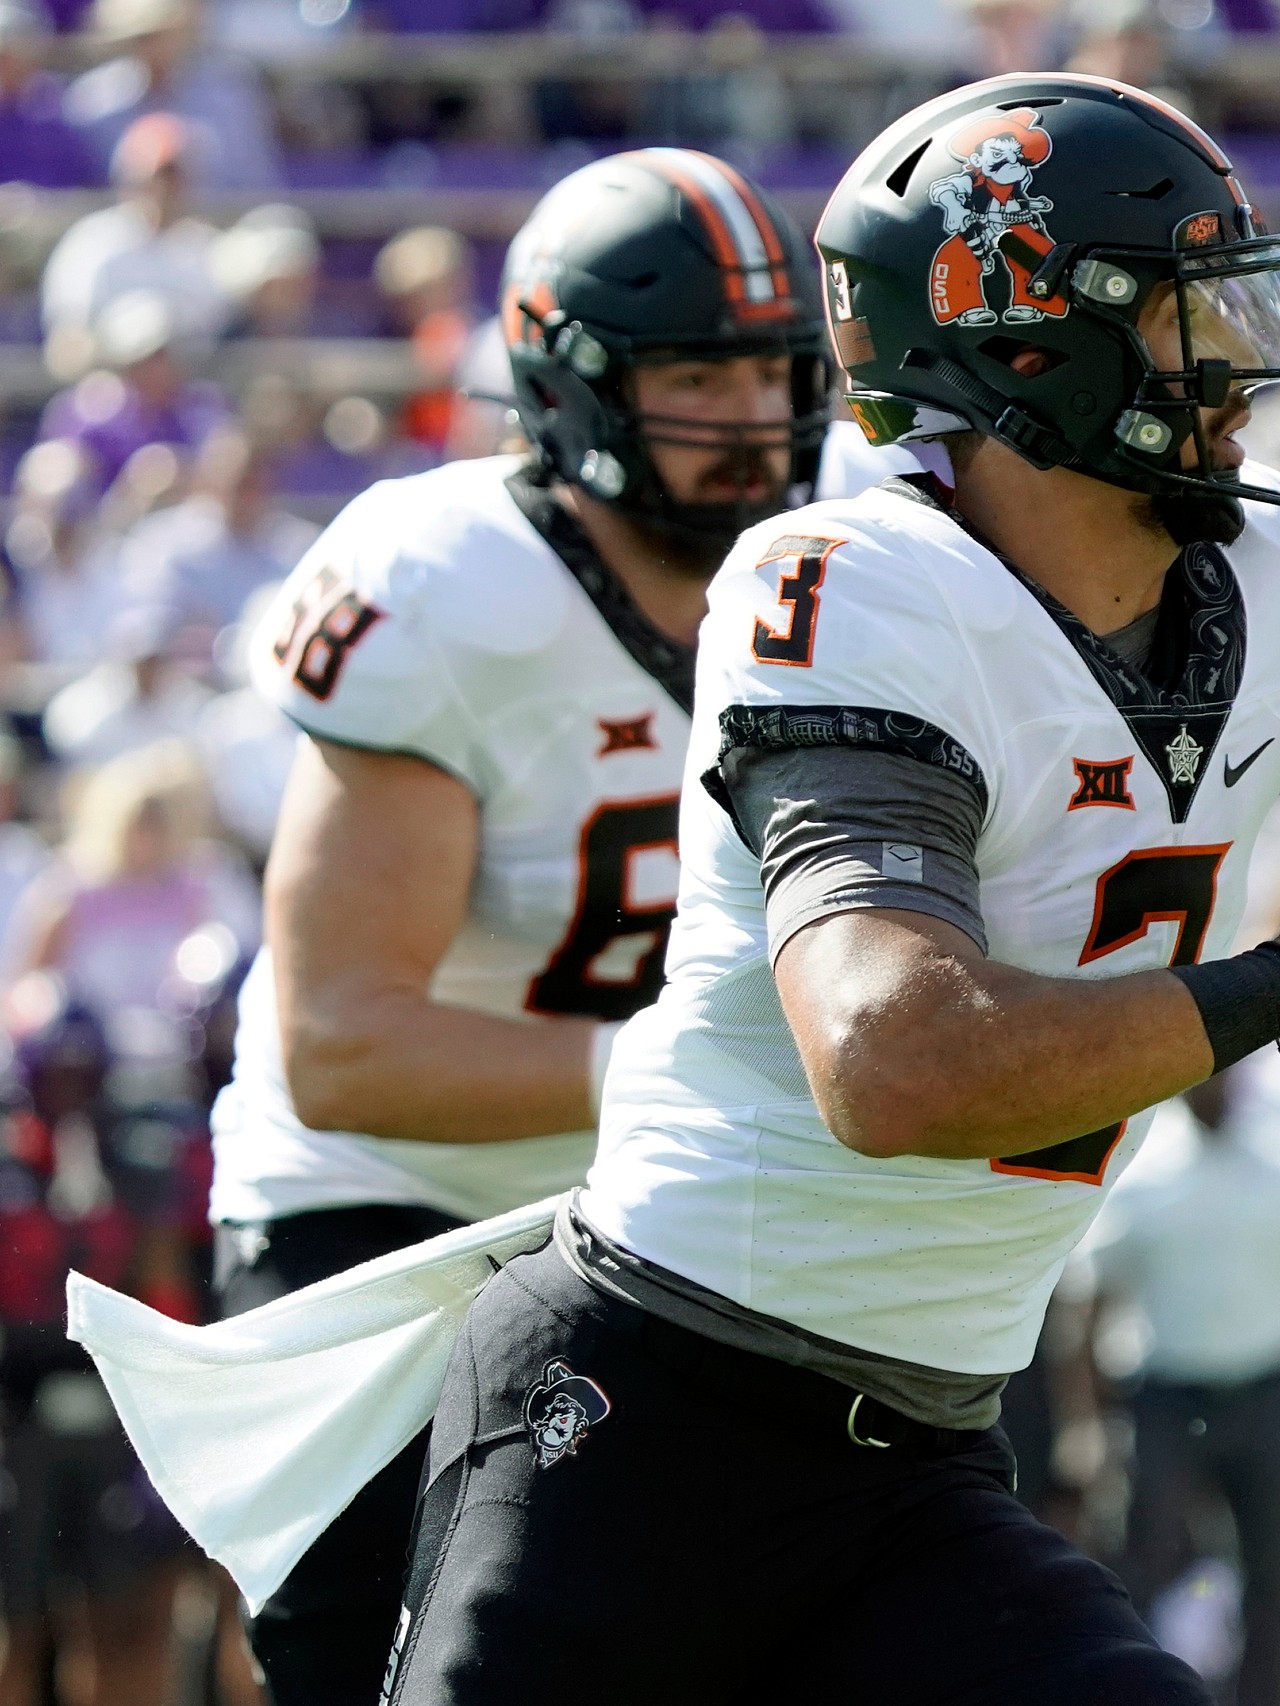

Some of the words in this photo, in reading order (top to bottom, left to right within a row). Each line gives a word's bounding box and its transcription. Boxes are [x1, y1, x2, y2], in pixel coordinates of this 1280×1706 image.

[933, 262, 951, 315] OSU
[750, 534, 849, 668] 3
[1068, 754, 1136, 812] XII
